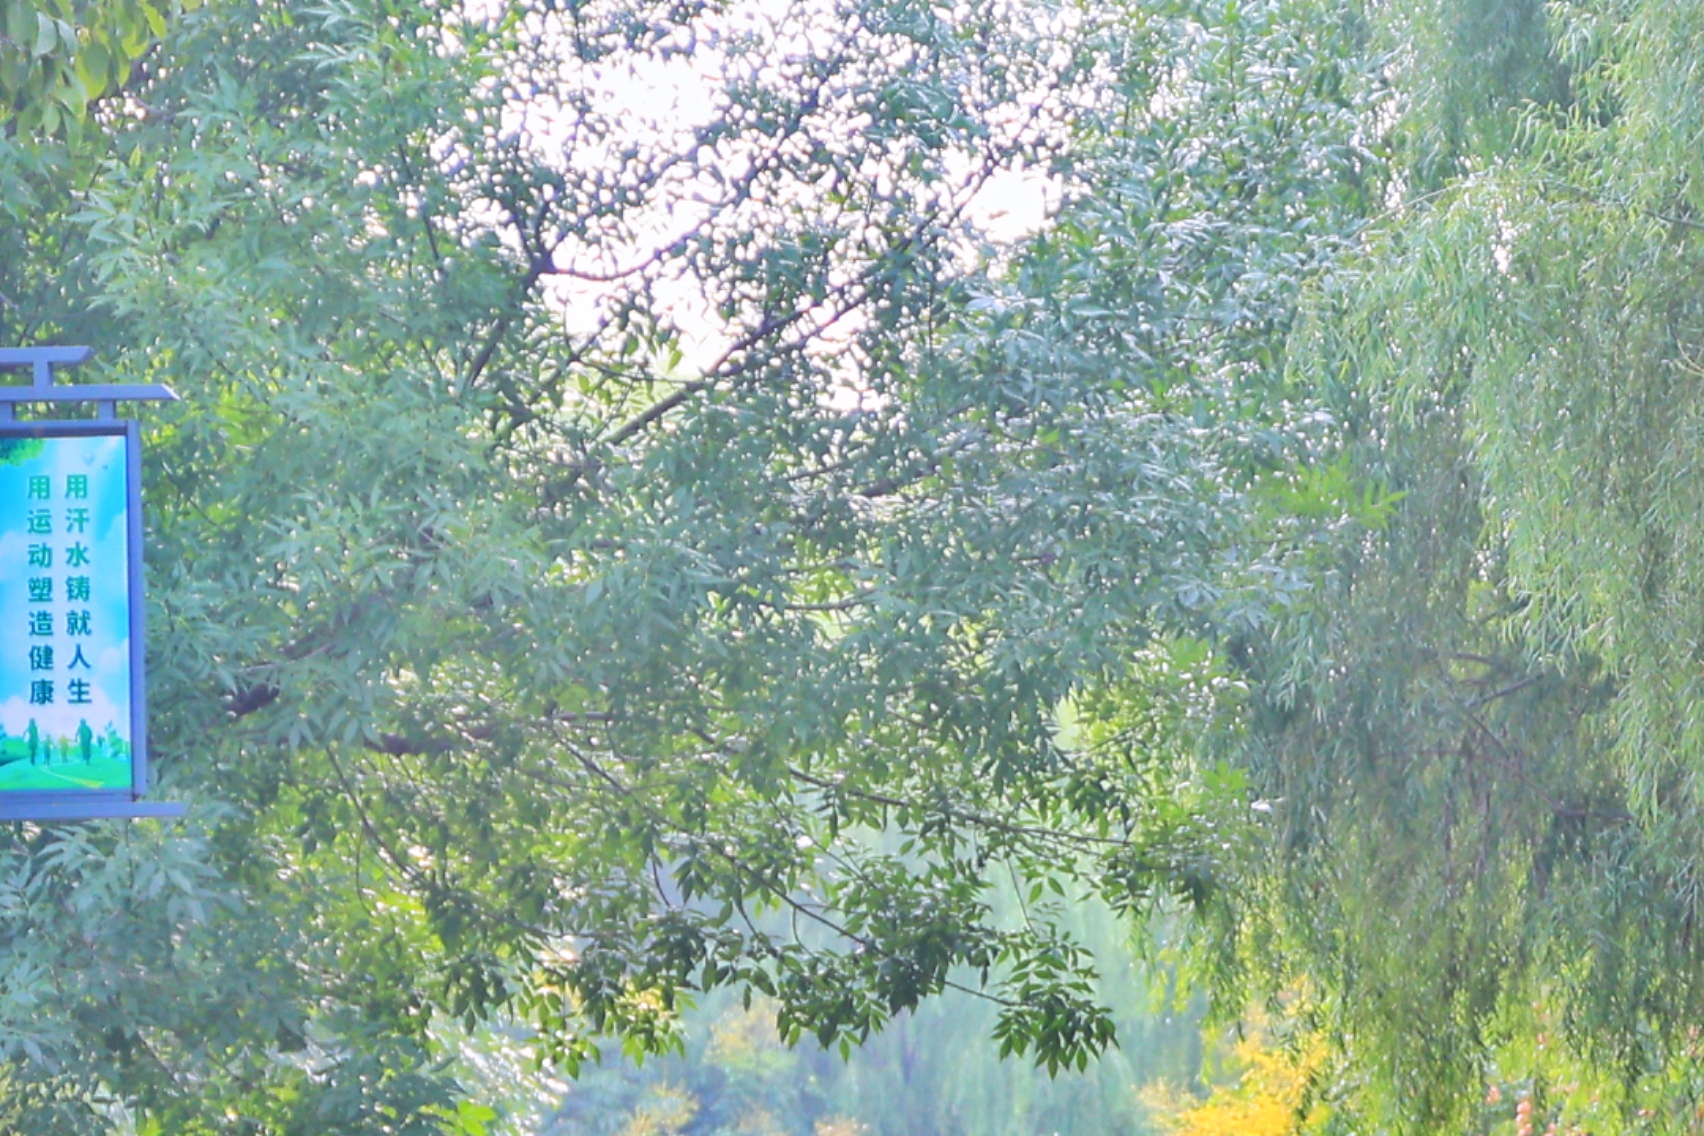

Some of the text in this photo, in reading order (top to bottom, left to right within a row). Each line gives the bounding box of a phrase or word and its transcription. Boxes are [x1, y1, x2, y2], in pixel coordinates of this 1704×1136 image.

[27, 475, 54, 705] 用运动塑造健康
[65, 474, 92, 705] 用汗水铸就人生
